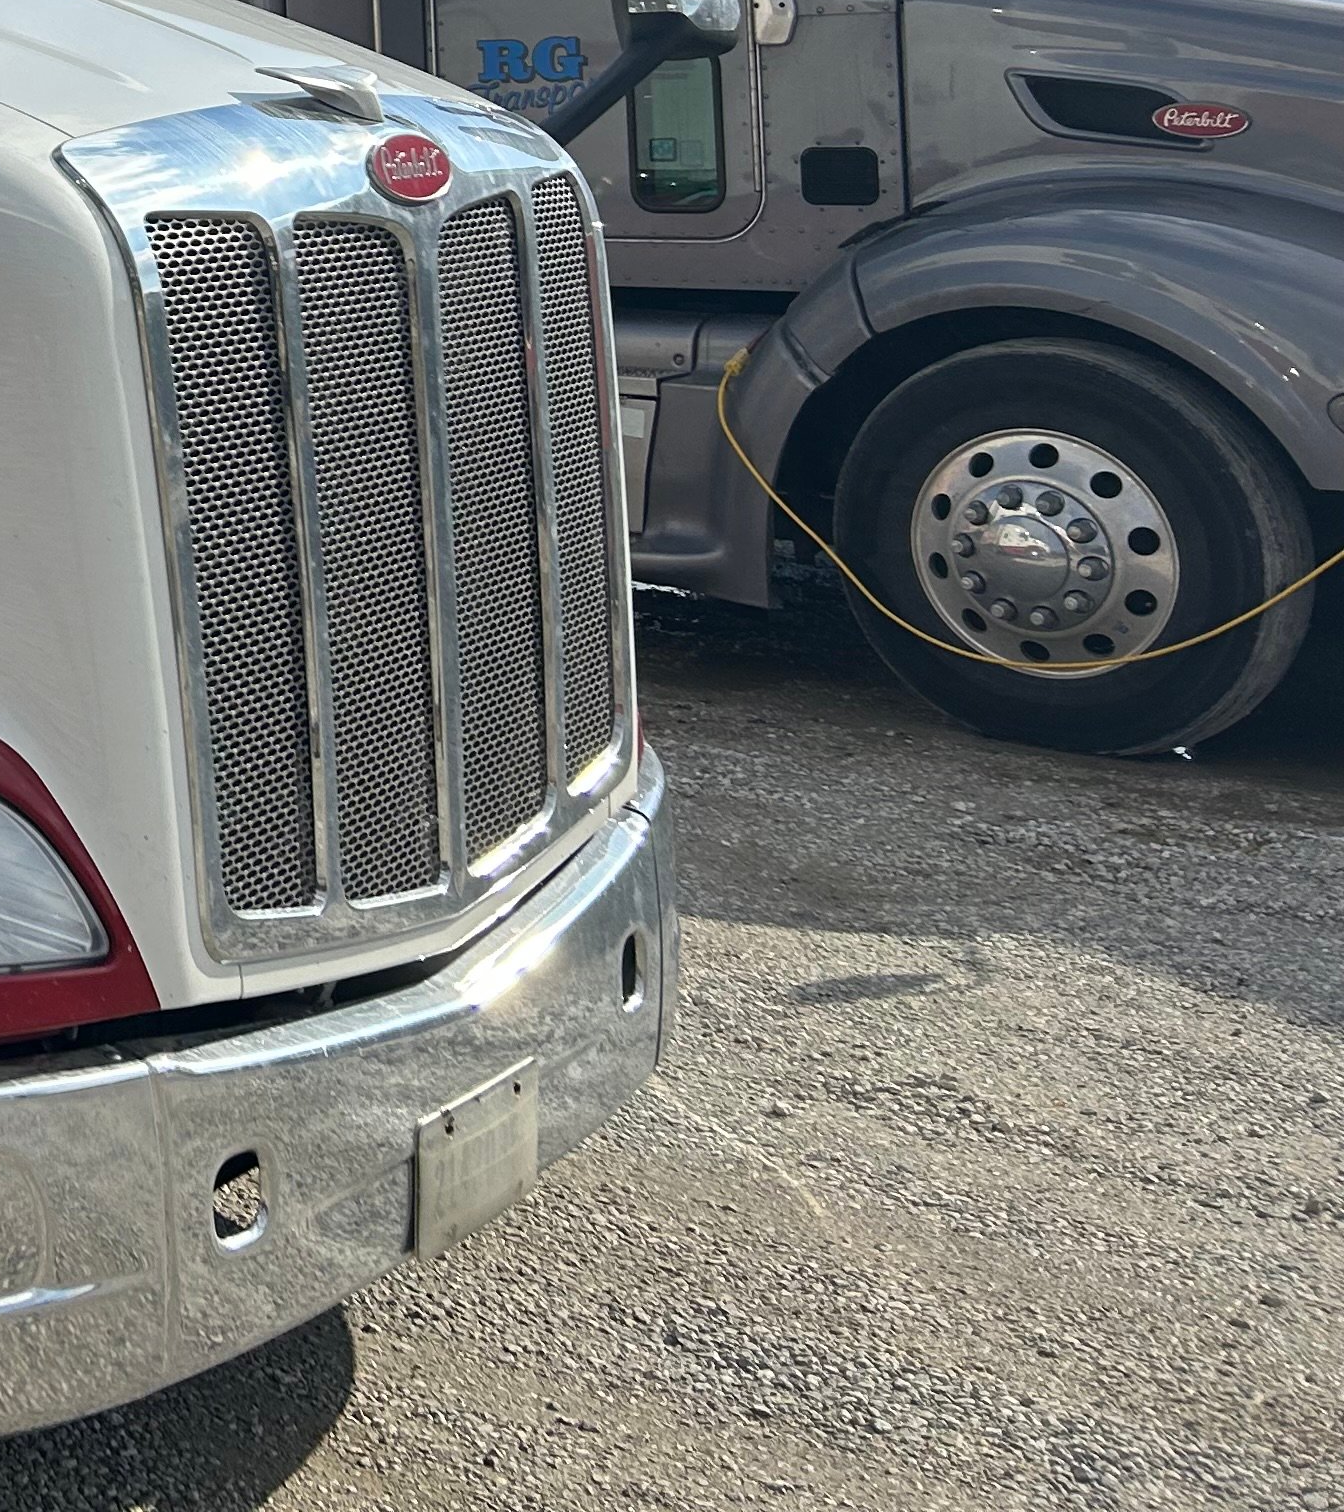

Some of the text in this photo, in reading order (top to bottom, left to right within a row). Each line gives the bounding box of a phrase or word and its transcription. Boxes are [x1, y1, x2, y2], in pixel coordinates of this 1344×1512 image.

[477, 36, 588, 84] RG
[1163, 108, 1240, 128] Peterbilt
[380, 146, 443, 185] Peterbilt
